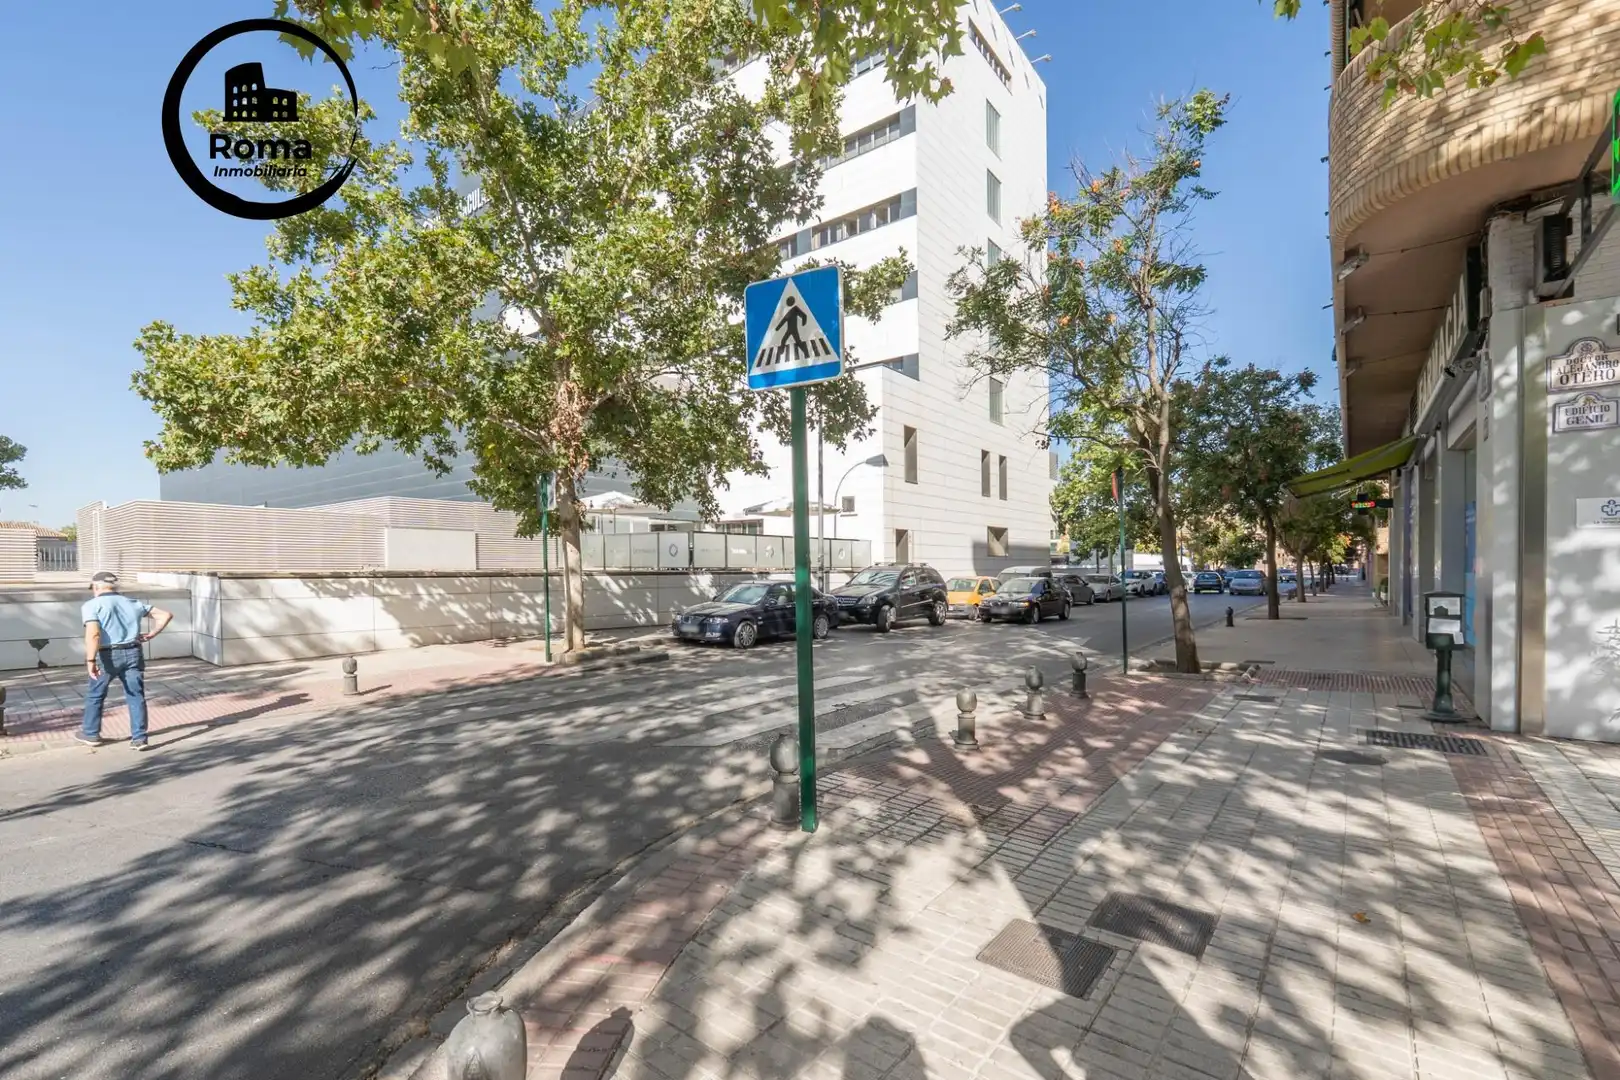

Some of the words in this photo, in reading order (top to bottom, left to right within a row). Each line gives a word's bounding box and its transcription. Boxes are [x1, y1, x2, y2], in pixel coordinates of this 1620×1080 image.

[1556, 359, 1619, 376] ALEJANDRO
[1566, 355, 1608, 366] DOCTOR
[1560, 369, 1616, 385] OTERO
[1566, 414, 1609, 426] GENIL
